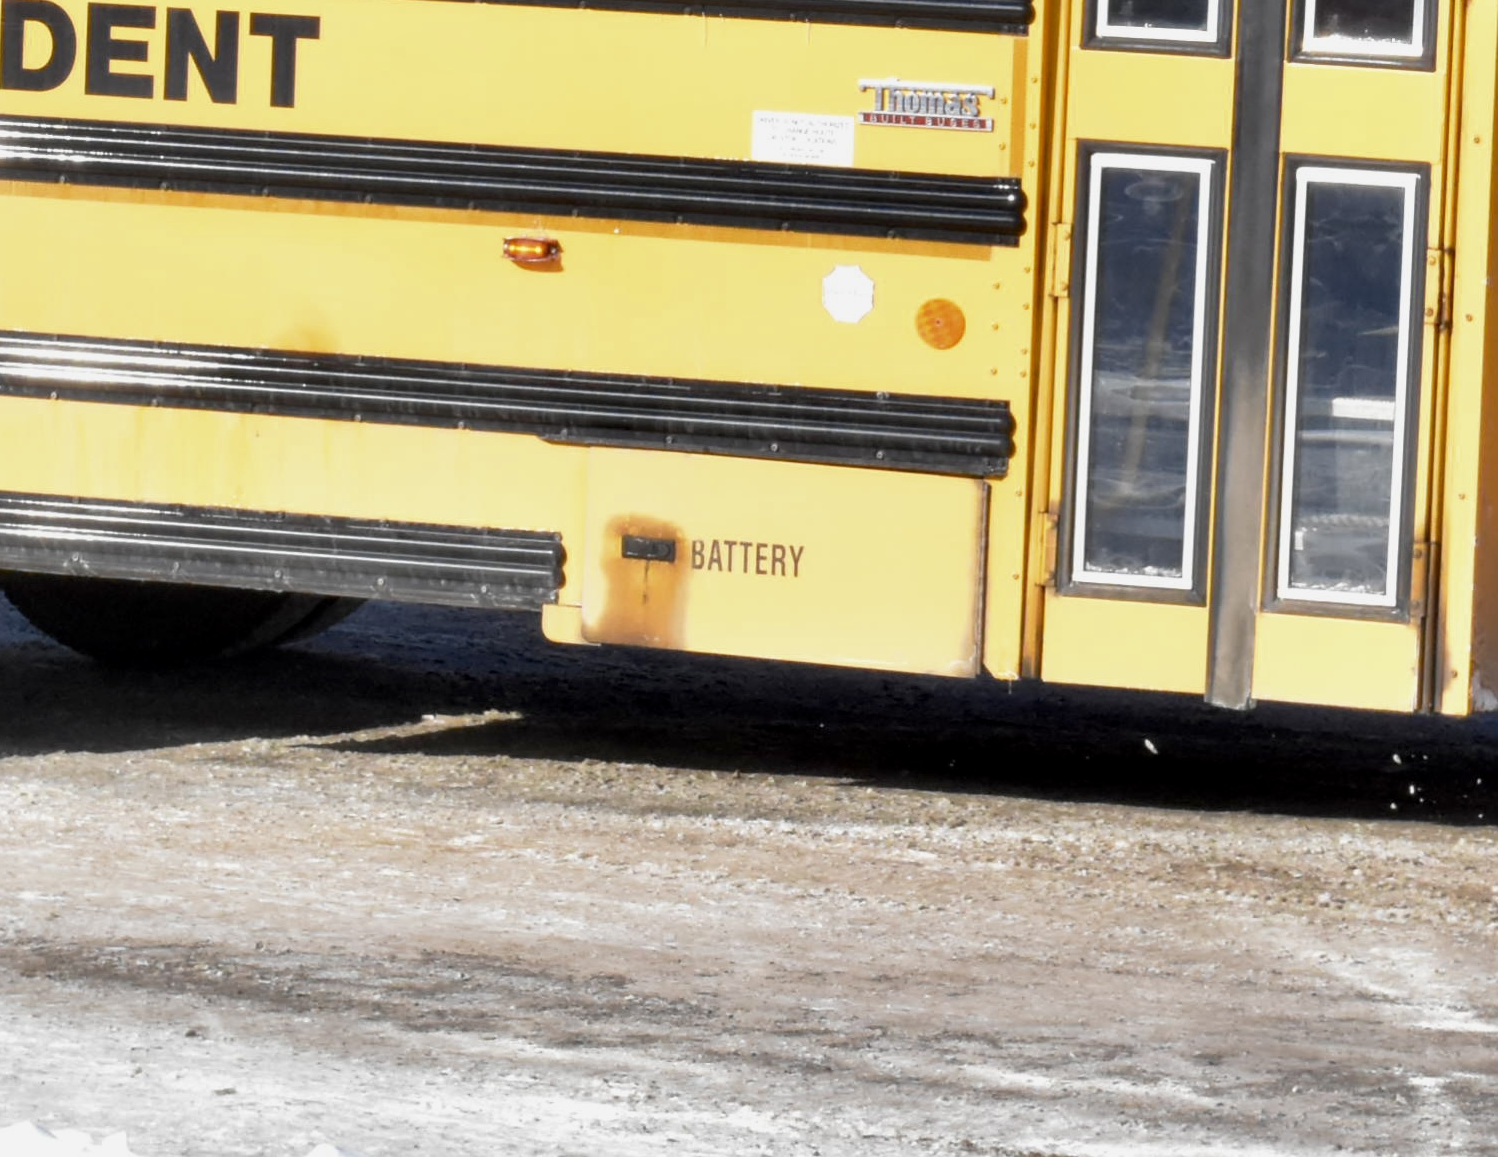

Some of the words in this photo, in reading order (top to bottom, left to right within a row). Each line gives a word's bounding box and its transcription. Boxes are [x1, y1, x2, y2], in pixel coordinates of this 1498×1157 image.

[858, 78, 995, 116] Thomas
[869, 113, 917, 126] BUILT
[925, 116, 982, 131] BUSES
[691, 538, 805, 578] BATTERY
